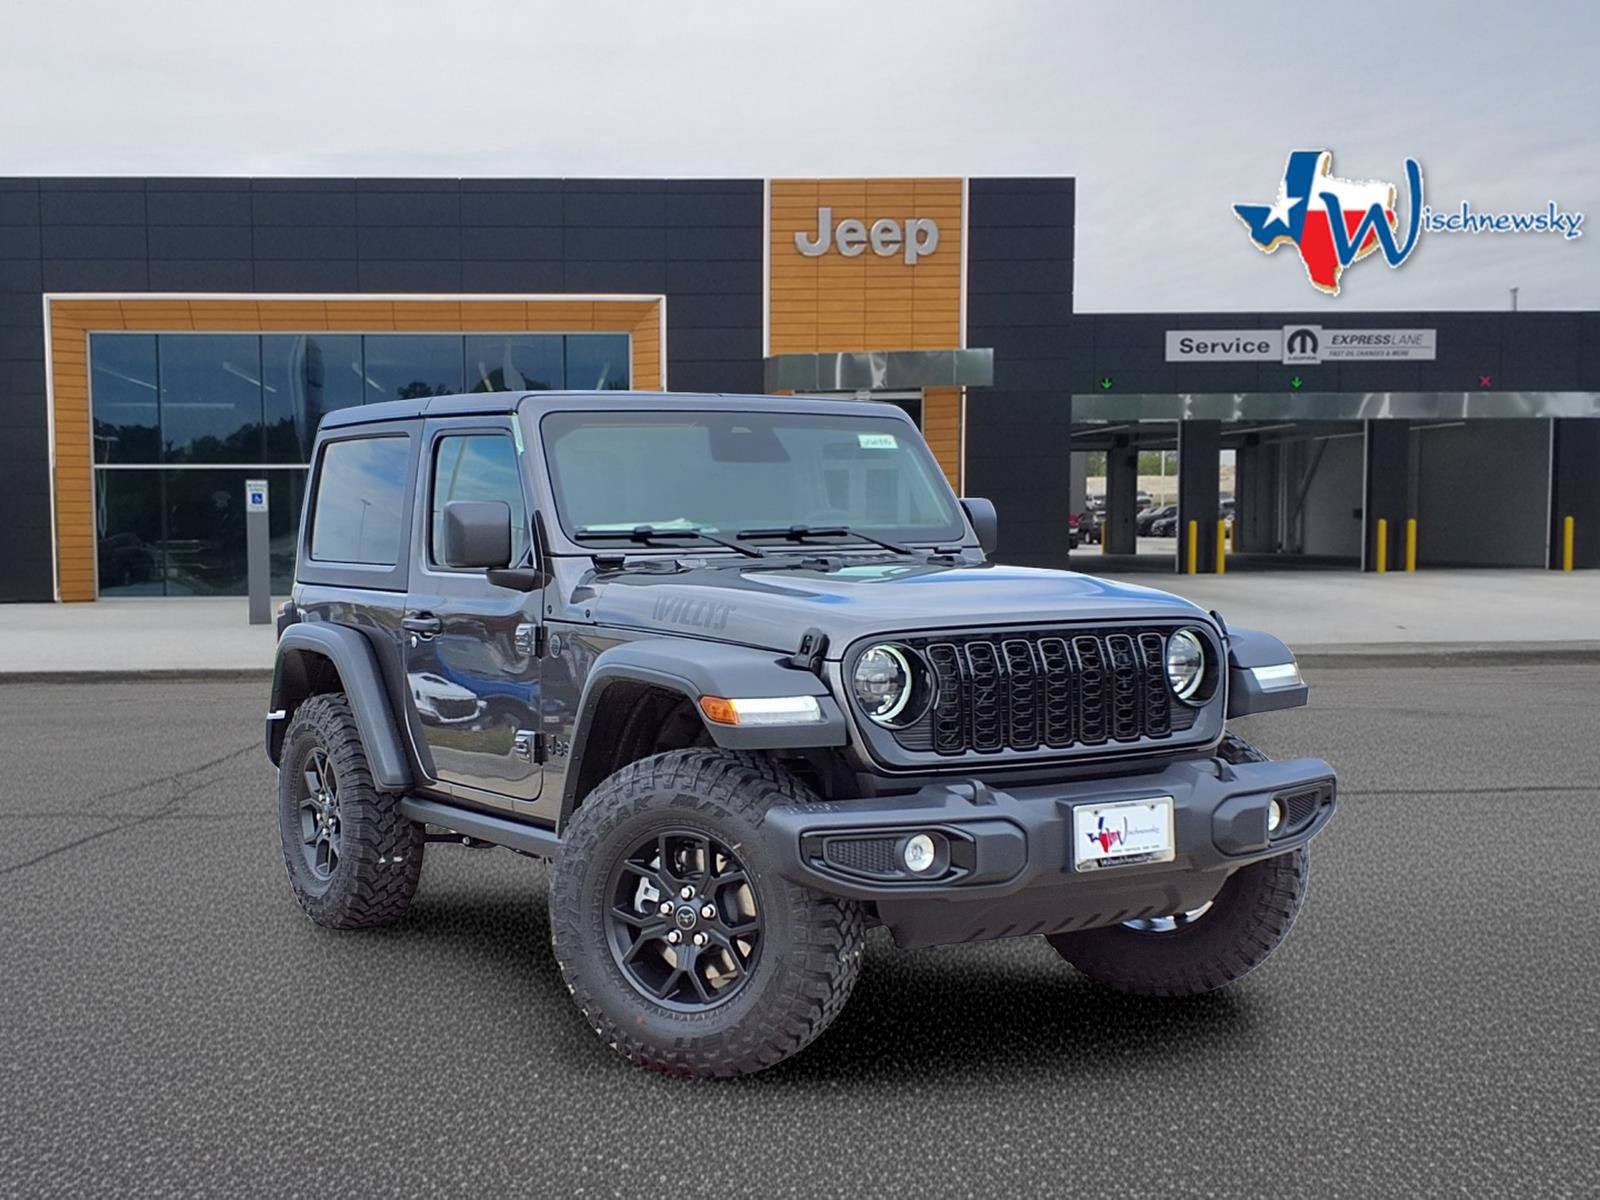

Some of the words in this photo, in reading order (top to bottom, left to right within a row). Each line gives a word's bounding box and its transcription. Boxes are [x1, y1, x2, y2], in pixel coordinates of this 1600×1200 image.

[794, 207, 940, 265] Jeep
[1179, 338, 1271, 354] Service
[545, 734, 571, 757] Jee
